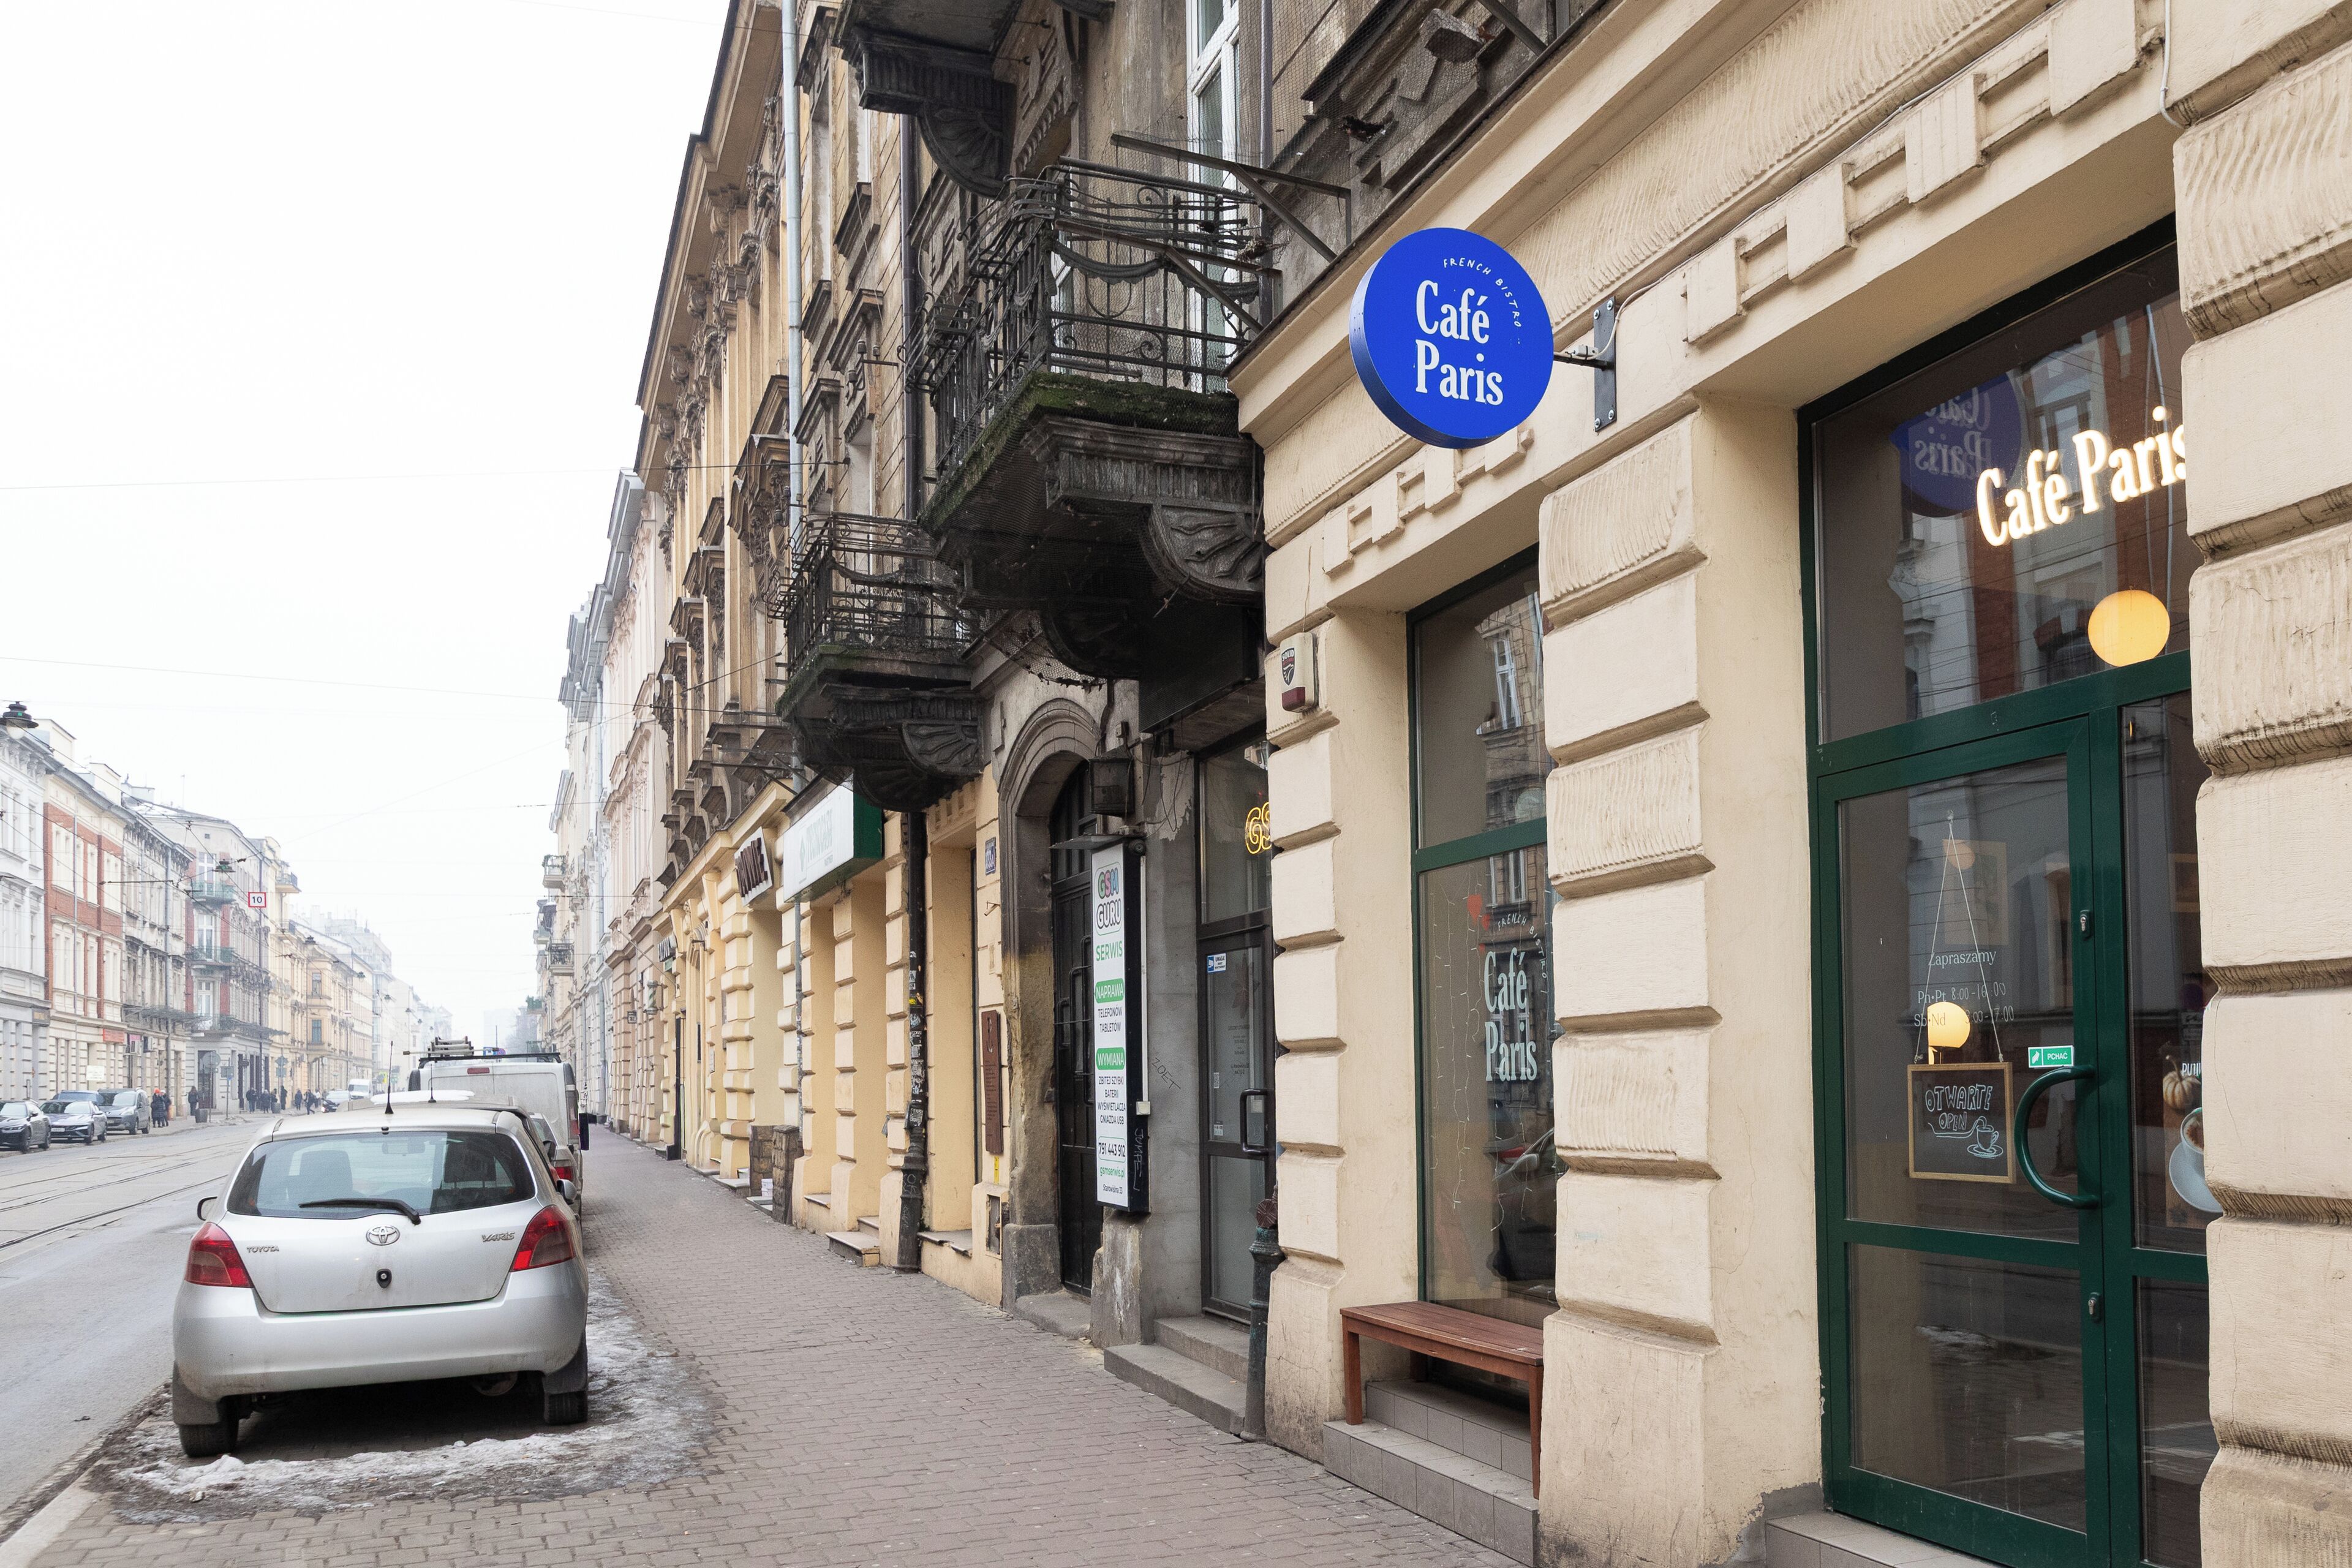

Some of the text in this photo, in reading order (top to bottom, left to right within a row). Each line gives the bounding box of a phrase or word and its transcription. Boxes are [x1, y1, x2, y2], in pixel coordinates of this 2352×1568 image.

[1443, 257, 1521, 327] FRENCH BISTRO
[1416, 279, 1490, 344] Café
[1415, 339, 1504, 405] Paris
[1977, 448, 2071, 546] Café
[1282, 649, 1294, 662] SOLID
[1098, 867, 1119, 899] GSM
[1096, 898, 1121, 929] GURU
[1096, 940, 1123, 961] SERWIS
[1498, 913, 1547, 979] FRENCH BISTRO
[1928, 951, 1996, 969] Zapraszamy
[1483, 947, 1527, 1012] Café
[1096, 983, 1124, 1000] NAPRAWA
[1098, 1005, 1123, 1018] TELEFONÓW
[1099, 1020, 1121, 1033] TABLETÓW
[1097, 1052, 1125, 1066] WYMIANA
[1484, 1021, 1538, 1082] Paris
[2047, 1051, 2068, 1060] PCHAĆ
[1098, 1076, 1111, 1085] ZBITEJ
[1104, 1089, 1119, 1098] BATERII
[1925, 1084, 1993, 1112] OTWARTE
[1098, 1100, 1126, 1112] WYŚWIETLACZA
[1100, 1115, 1116, 1125] GNIAZDA
[1939, 1112, 1967, 1131] OPEN
[1098, 1142, 1107, 1155] 791
[1107, 1144, 1117, 1156] 443
[1100, 1166, 1125, 1180] gsmserwis.pl
[481, 1231, 515, 1243] YARIS
[246, 1245, 280, 1254] TOYOTA
